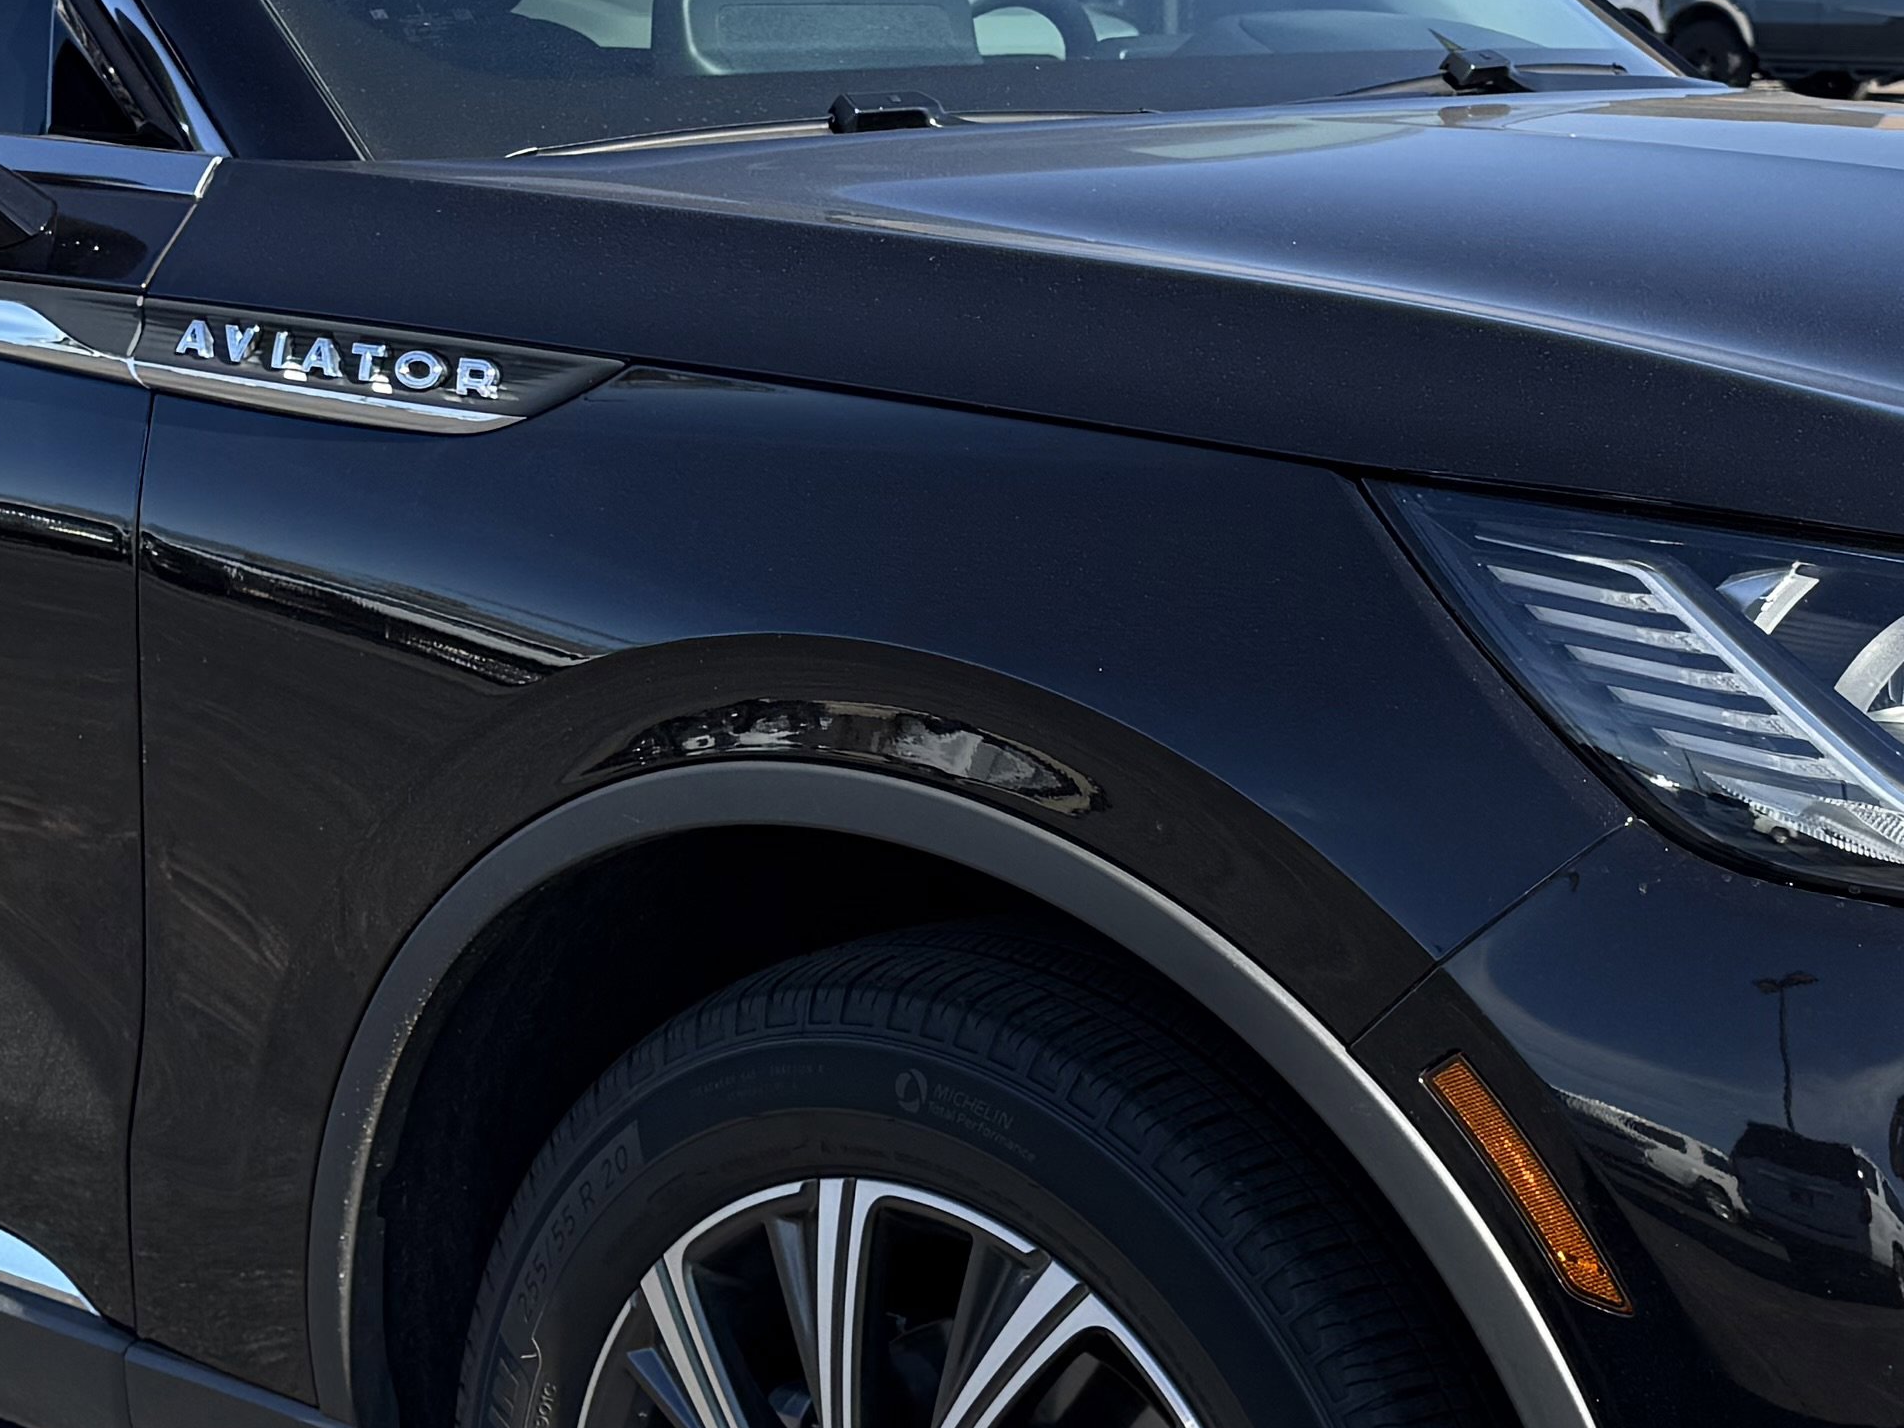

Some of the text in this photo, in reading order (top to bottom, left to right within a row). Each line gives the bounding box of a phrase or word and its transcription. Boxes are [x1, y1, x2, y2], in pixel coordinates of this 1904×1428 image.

[175, 320, 501, 399] AVIATOR
[933, 1083, 1014, 1130] MICHELIN
[601, 1144, 629, 1191] 20
